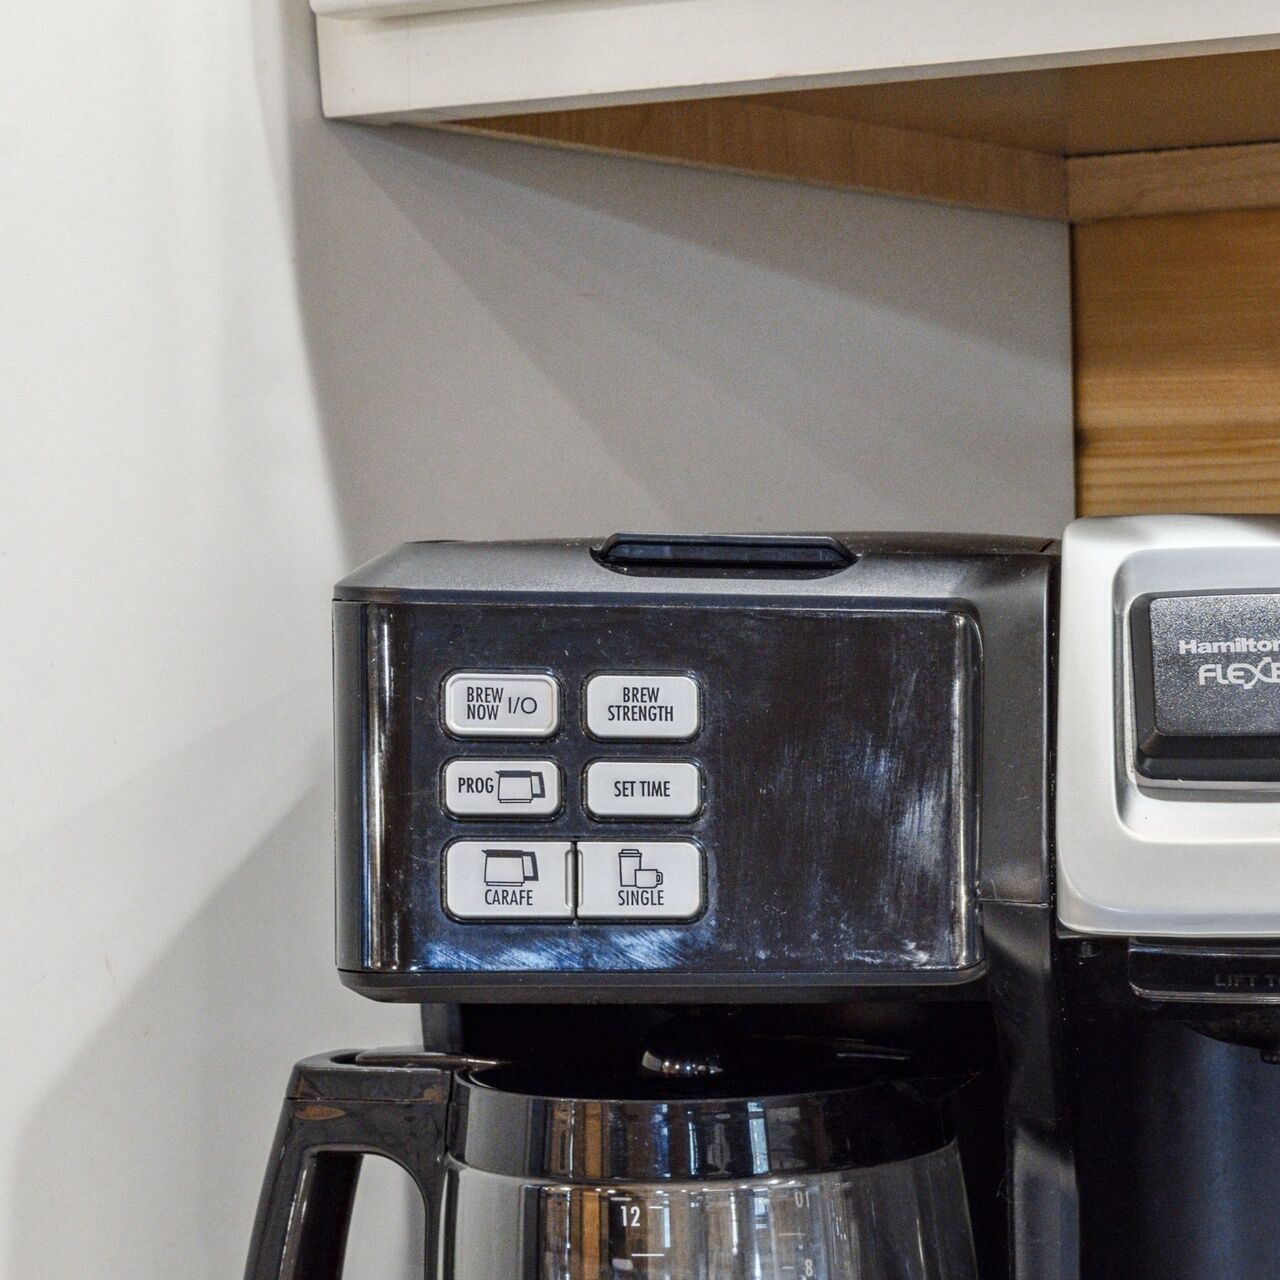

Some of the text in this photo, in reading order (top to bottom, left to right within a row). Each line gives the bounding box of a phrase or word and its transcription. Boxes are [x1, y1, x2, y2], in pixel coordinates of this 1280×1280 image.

[466, 686, 504, 703] BREW
[622, 686, 660, 703] BREW
[466, 704, 499, 721] NOW
[607, 705, 674, 722] STRENGTH
[457, 777, 494, 794] PROG
[614, 781, 671, 798] SET TIME
[484, 888, 533, 906] CARAFE
[617, 889, 664, 906] SINGLE
[1214, 974, 1257, 987] LIFT
[620, 1205, 641, 1227] 12
